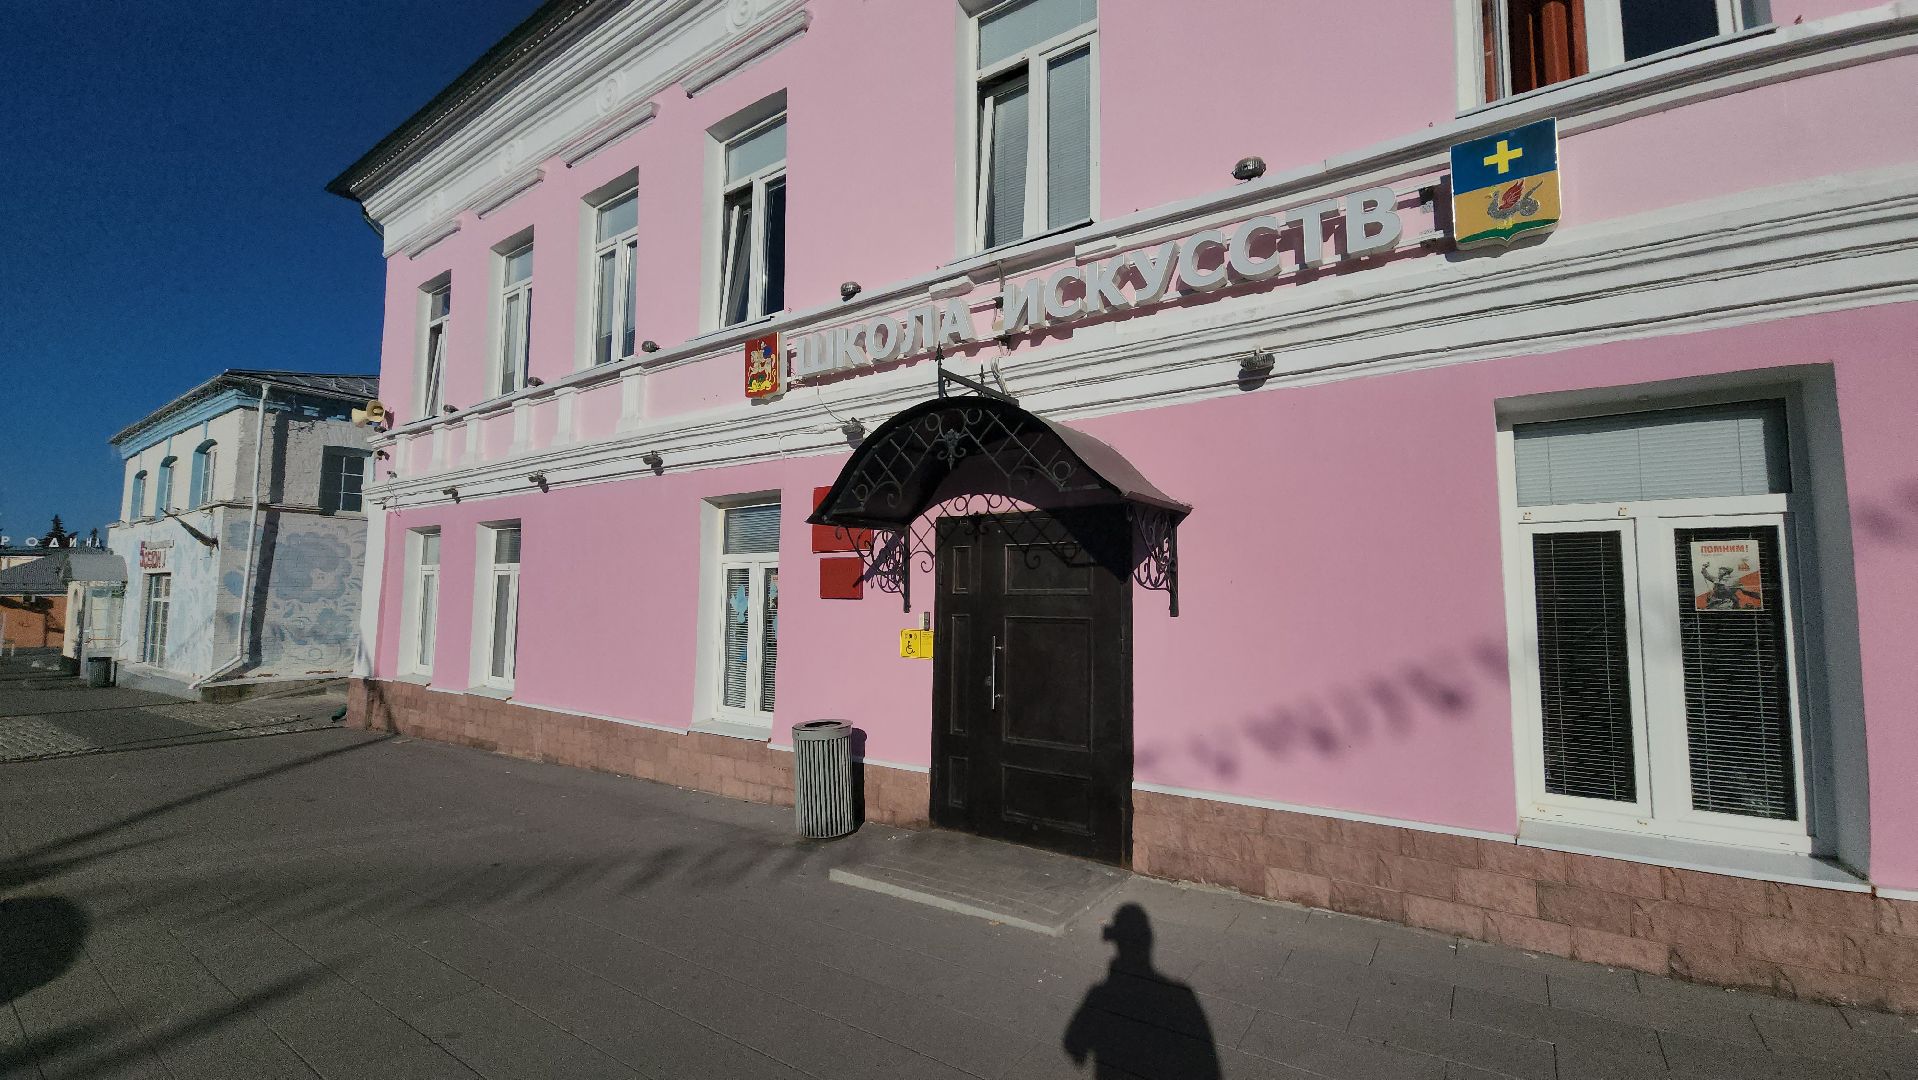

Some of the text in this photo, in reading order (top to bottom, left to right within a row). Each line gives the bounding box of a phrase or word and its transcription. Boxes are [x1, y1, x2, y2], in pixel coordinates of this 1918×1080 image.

[796, 186, 1402, 375] ШКОЛА ИСКУССТВ
[0, 537, 100, 548] РОДИНА
[1701, 545, 1749, 553] ПОМНИМ!
